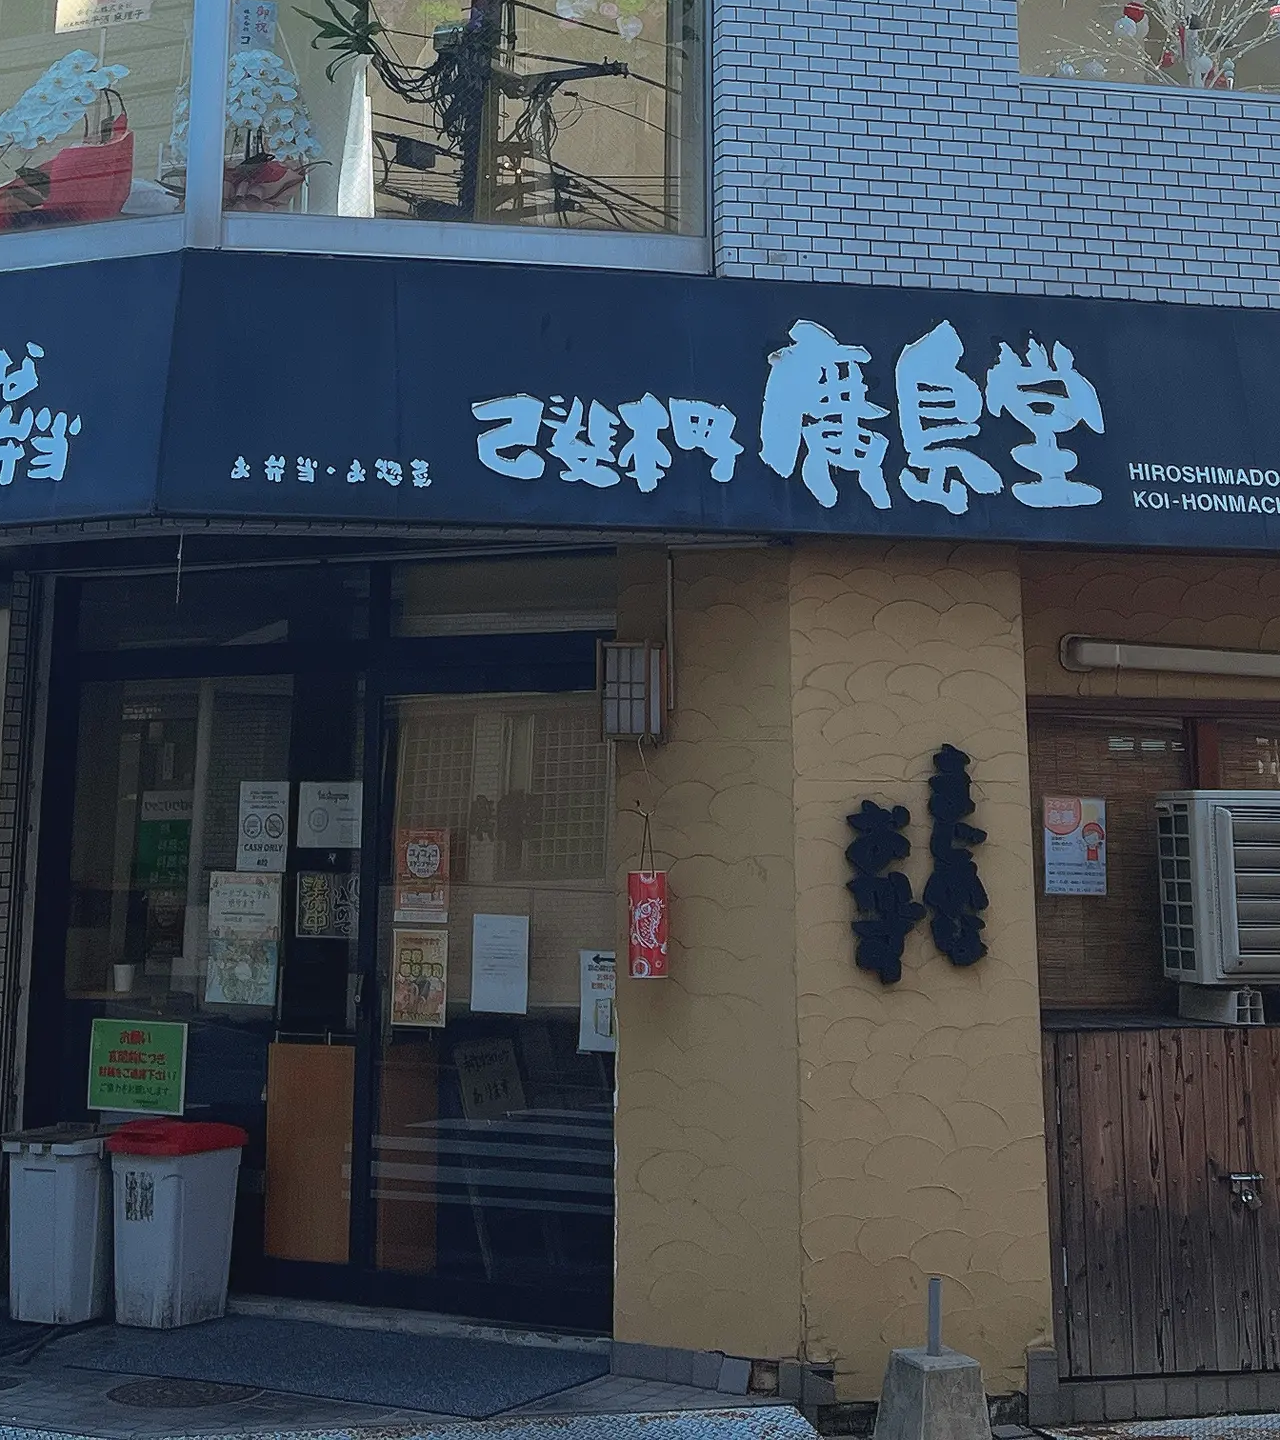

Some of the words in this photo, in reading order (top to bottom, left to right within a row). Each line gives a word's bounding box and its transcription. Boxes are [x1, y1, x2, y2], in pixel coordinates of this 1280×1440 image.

[256, 5, 270, 34] 御祝
[759, 318, 1106, 515] 廣島堂
[471, 392, 745, 492] 己斐本町
[229, 455, 433, 490] お弁当・お惣菜
[1129, 461, 1280, 488] HIROSHIMADO
[243, 843, 262, 852] CASH
[264, 843, 283, 852] ONLY
[301, 875, 329, 934] 準備中
[120, 1030, 152, 1045] お願い
